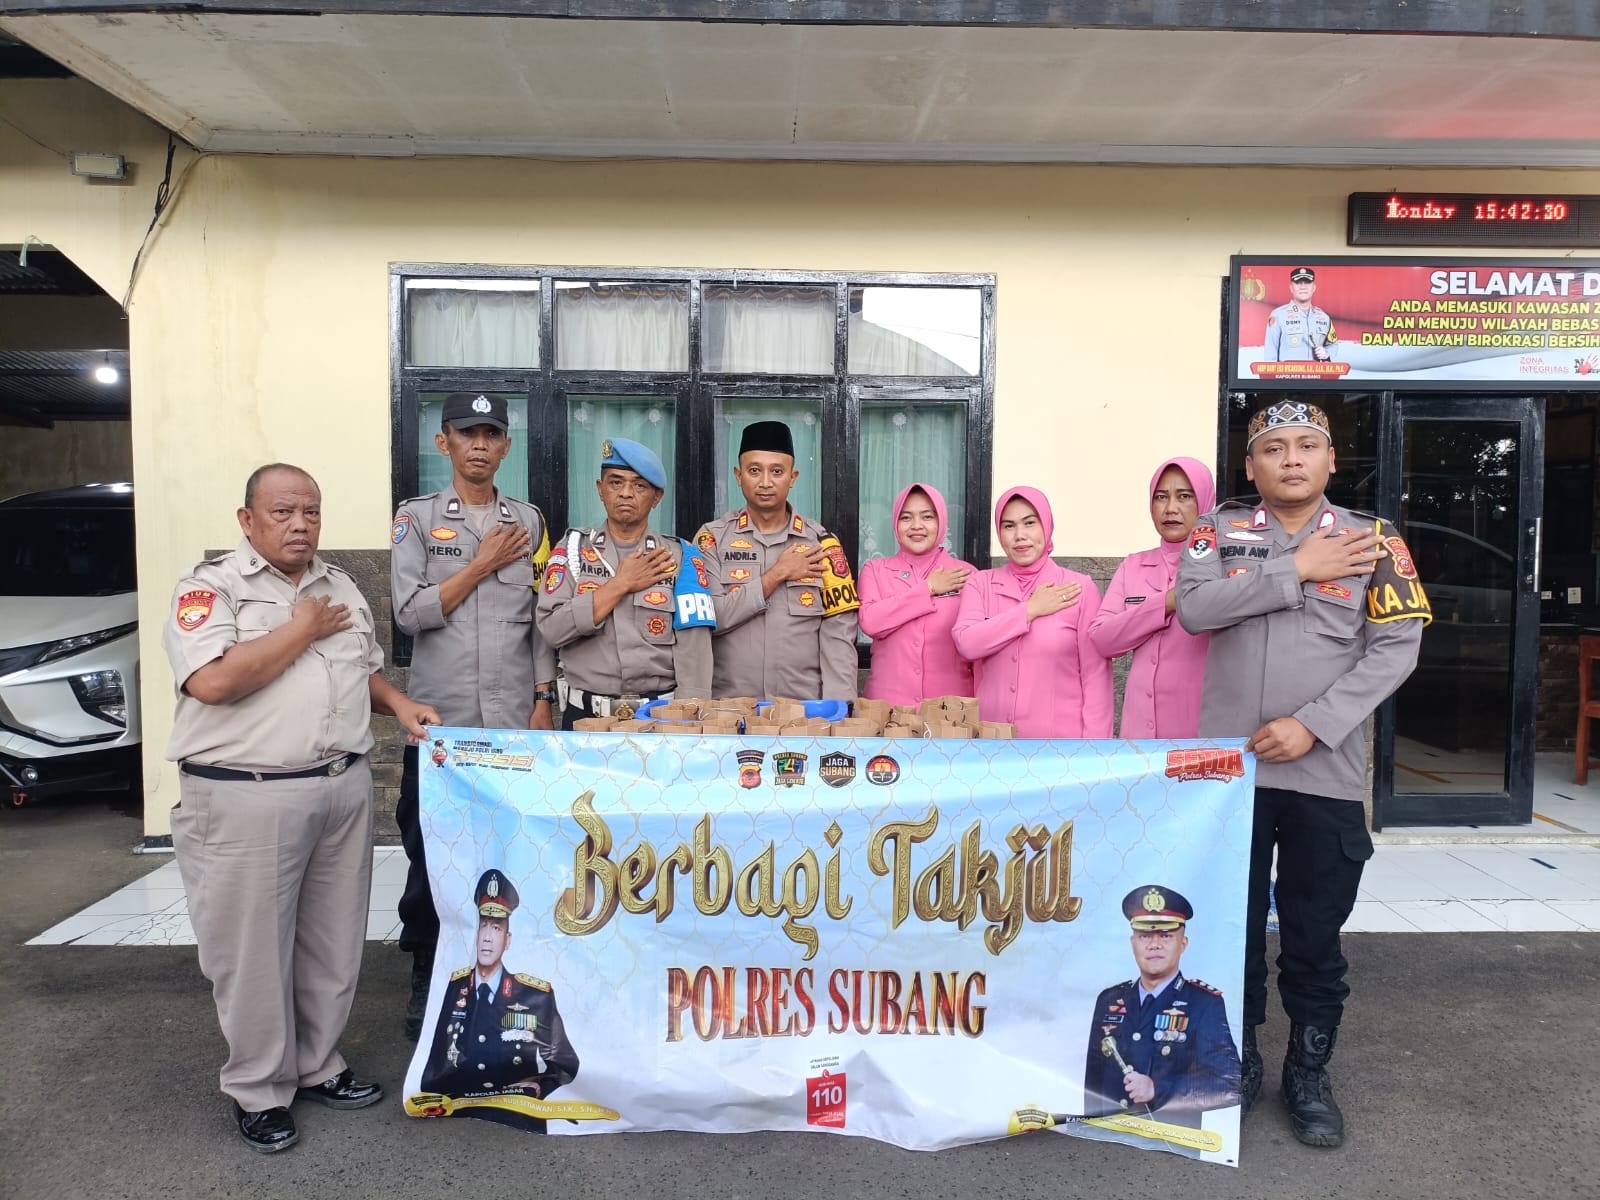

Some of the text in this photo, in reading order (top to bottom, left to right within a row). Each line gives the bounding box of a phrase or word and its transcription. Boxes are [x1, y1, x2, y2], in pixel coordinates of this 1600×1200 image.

[1475, 203, 1566, 220] 15:42:30
[1430, 271, 1575, 296] SELAMAT
[1390, 300, 1432, 314] ANDA
[1436, 301, 1512, 314] MEMASUKI
[1516, 302, 1590, 315] KAWASAN
[1383, 316, 1600, 332] DAN MENUJU WILAYAH BEBAS
[1362, 333, 1600, 348] DAN WILAYAH BIROKRASI BERSIH
[1519, 365, 1570, 374] INTEGRITAS
[428, 545, 463, 557] HERO
[724, 551, 757, 561] ANDRI.S
[1220, 546, 1269, 558] BENI AW
[825, 758, 849, 767] JAGA
[1166, 748, 1244, 777] SETIA
[819, 766, 856, 777] SUBANG
[1179, 770, 1231, 782] Polres Subang
[553, 789, 1083, 961] Berbagi Takjil
[665, 965, 987, 1043] POLRES SUBANG
[812, 1085, 843, 1107] 110
